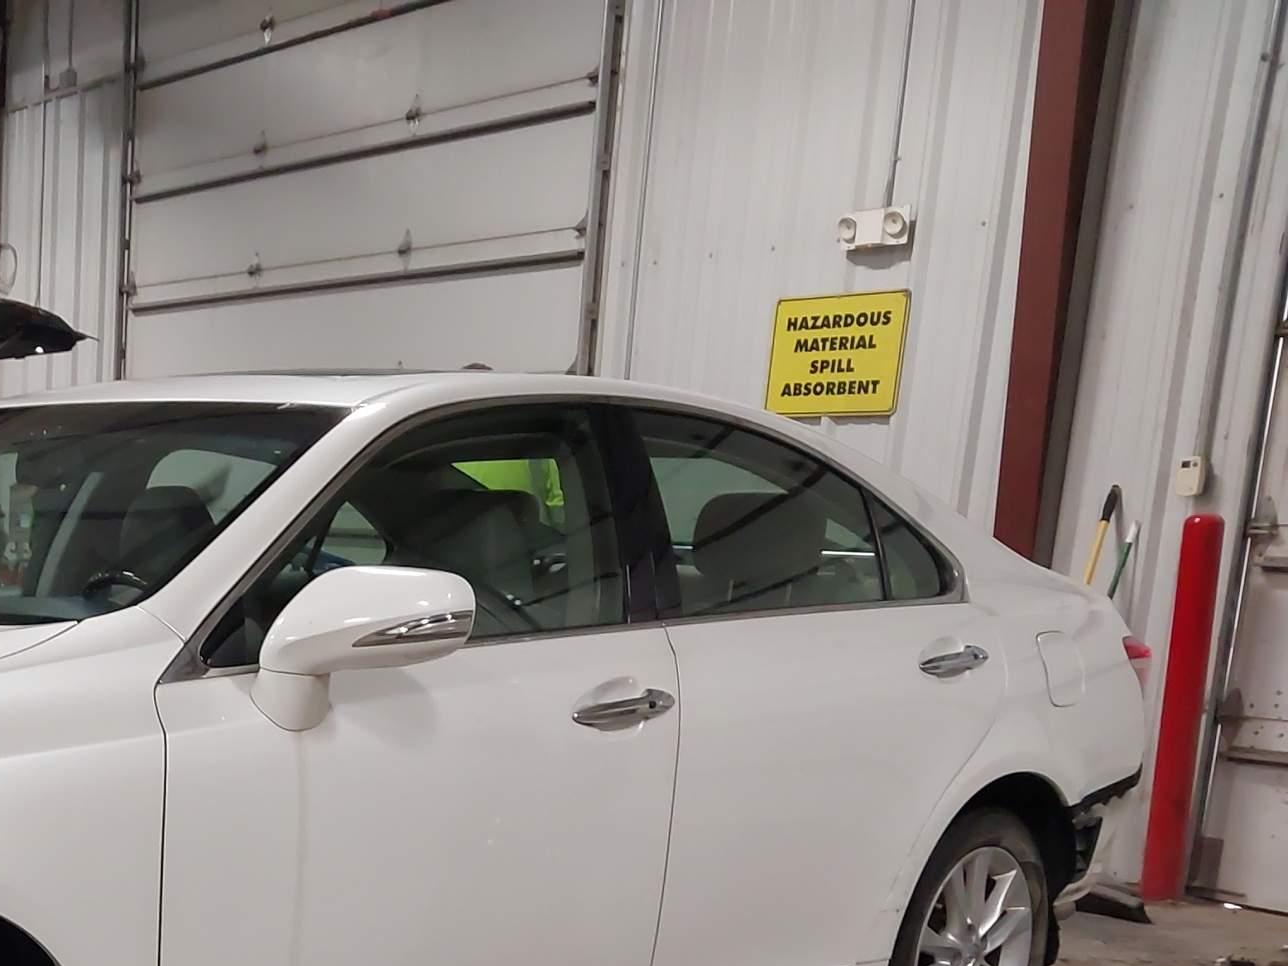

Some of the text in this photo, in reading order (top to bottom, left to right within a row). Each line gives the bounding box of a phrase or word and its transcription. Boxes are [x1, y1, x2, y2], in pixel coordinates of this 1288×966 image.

[786, 310, 892, 332] HAZARDOUS
[793, 334, 877, 353] MATERIAL
[809, 358, 855, 374] SPILL
[780, 379, 881, 397] ABSORBENT
